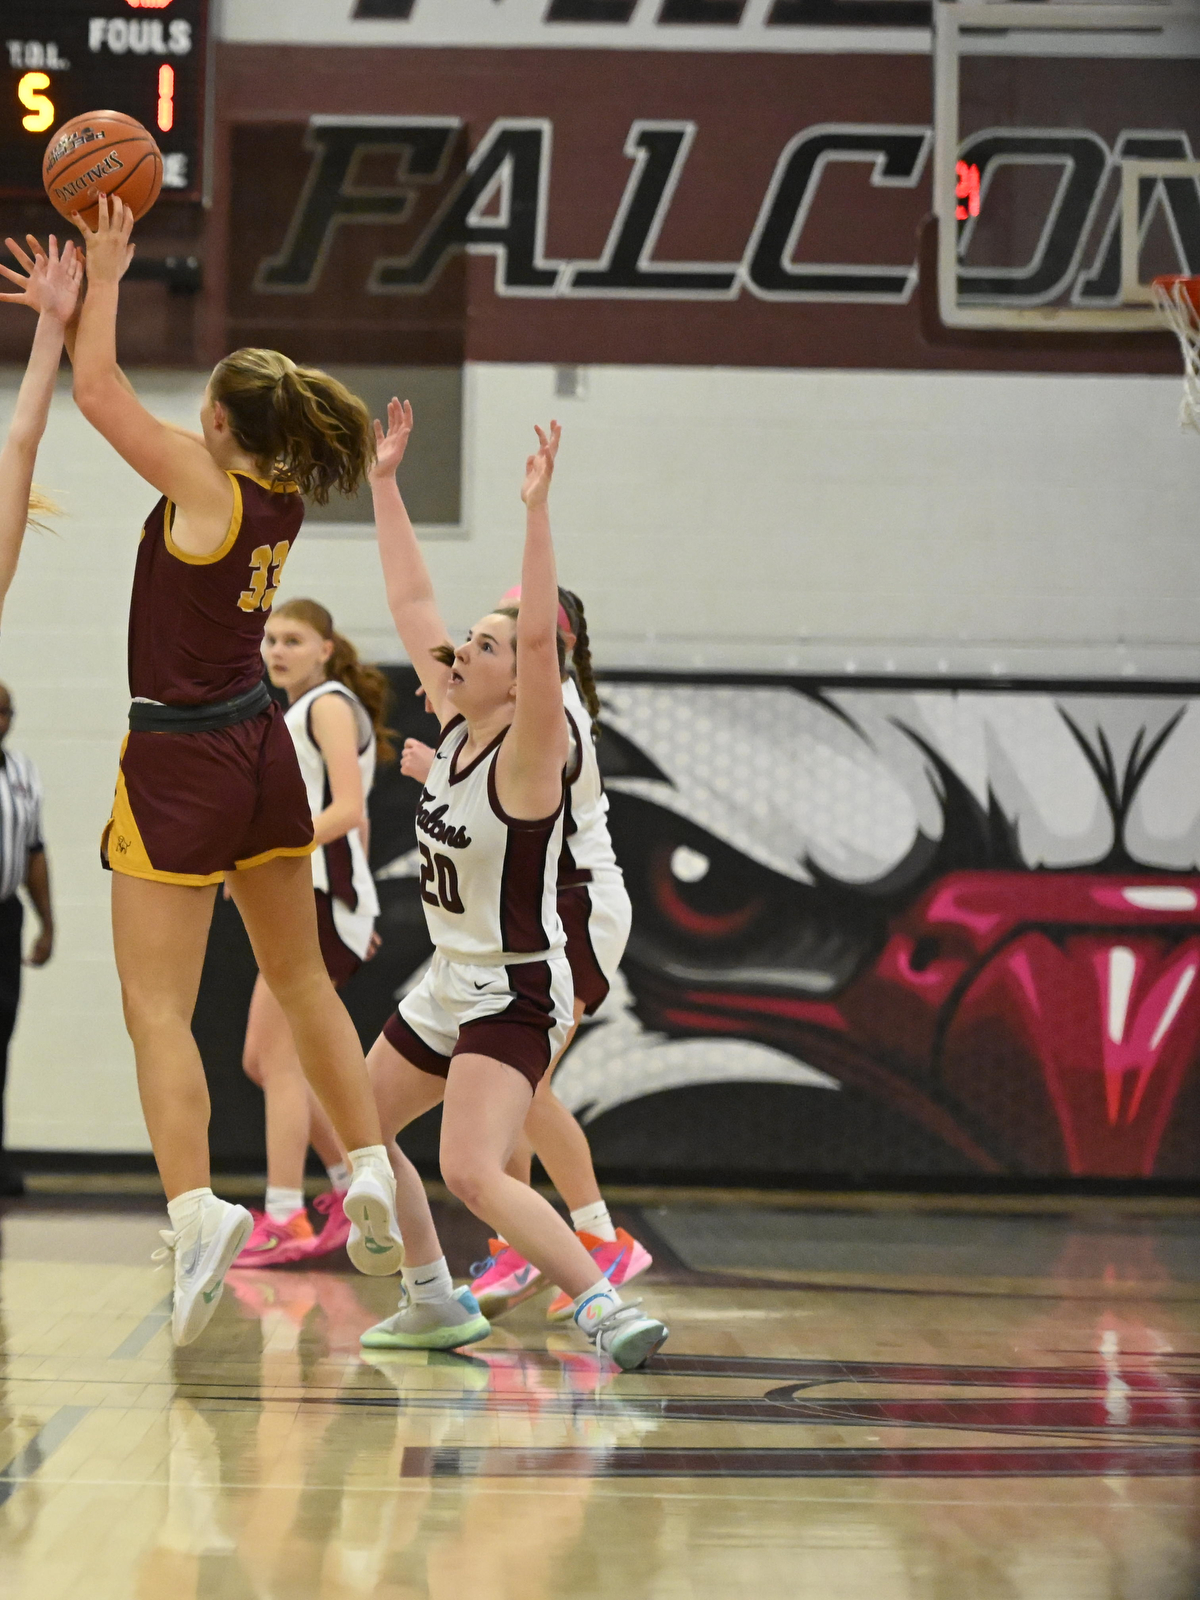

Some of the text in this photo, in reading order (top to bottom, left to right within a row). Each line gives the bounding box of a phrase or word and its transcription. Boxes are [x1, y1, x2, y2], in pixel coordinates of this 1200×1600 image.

[88, 17, 192, 55] FOULS
[18, 72, 55, 132] 5
[157, 64, 174, 132] 1
[55, 150, 124, 202] SPALDING
[418, 841, 465, 914] 20
